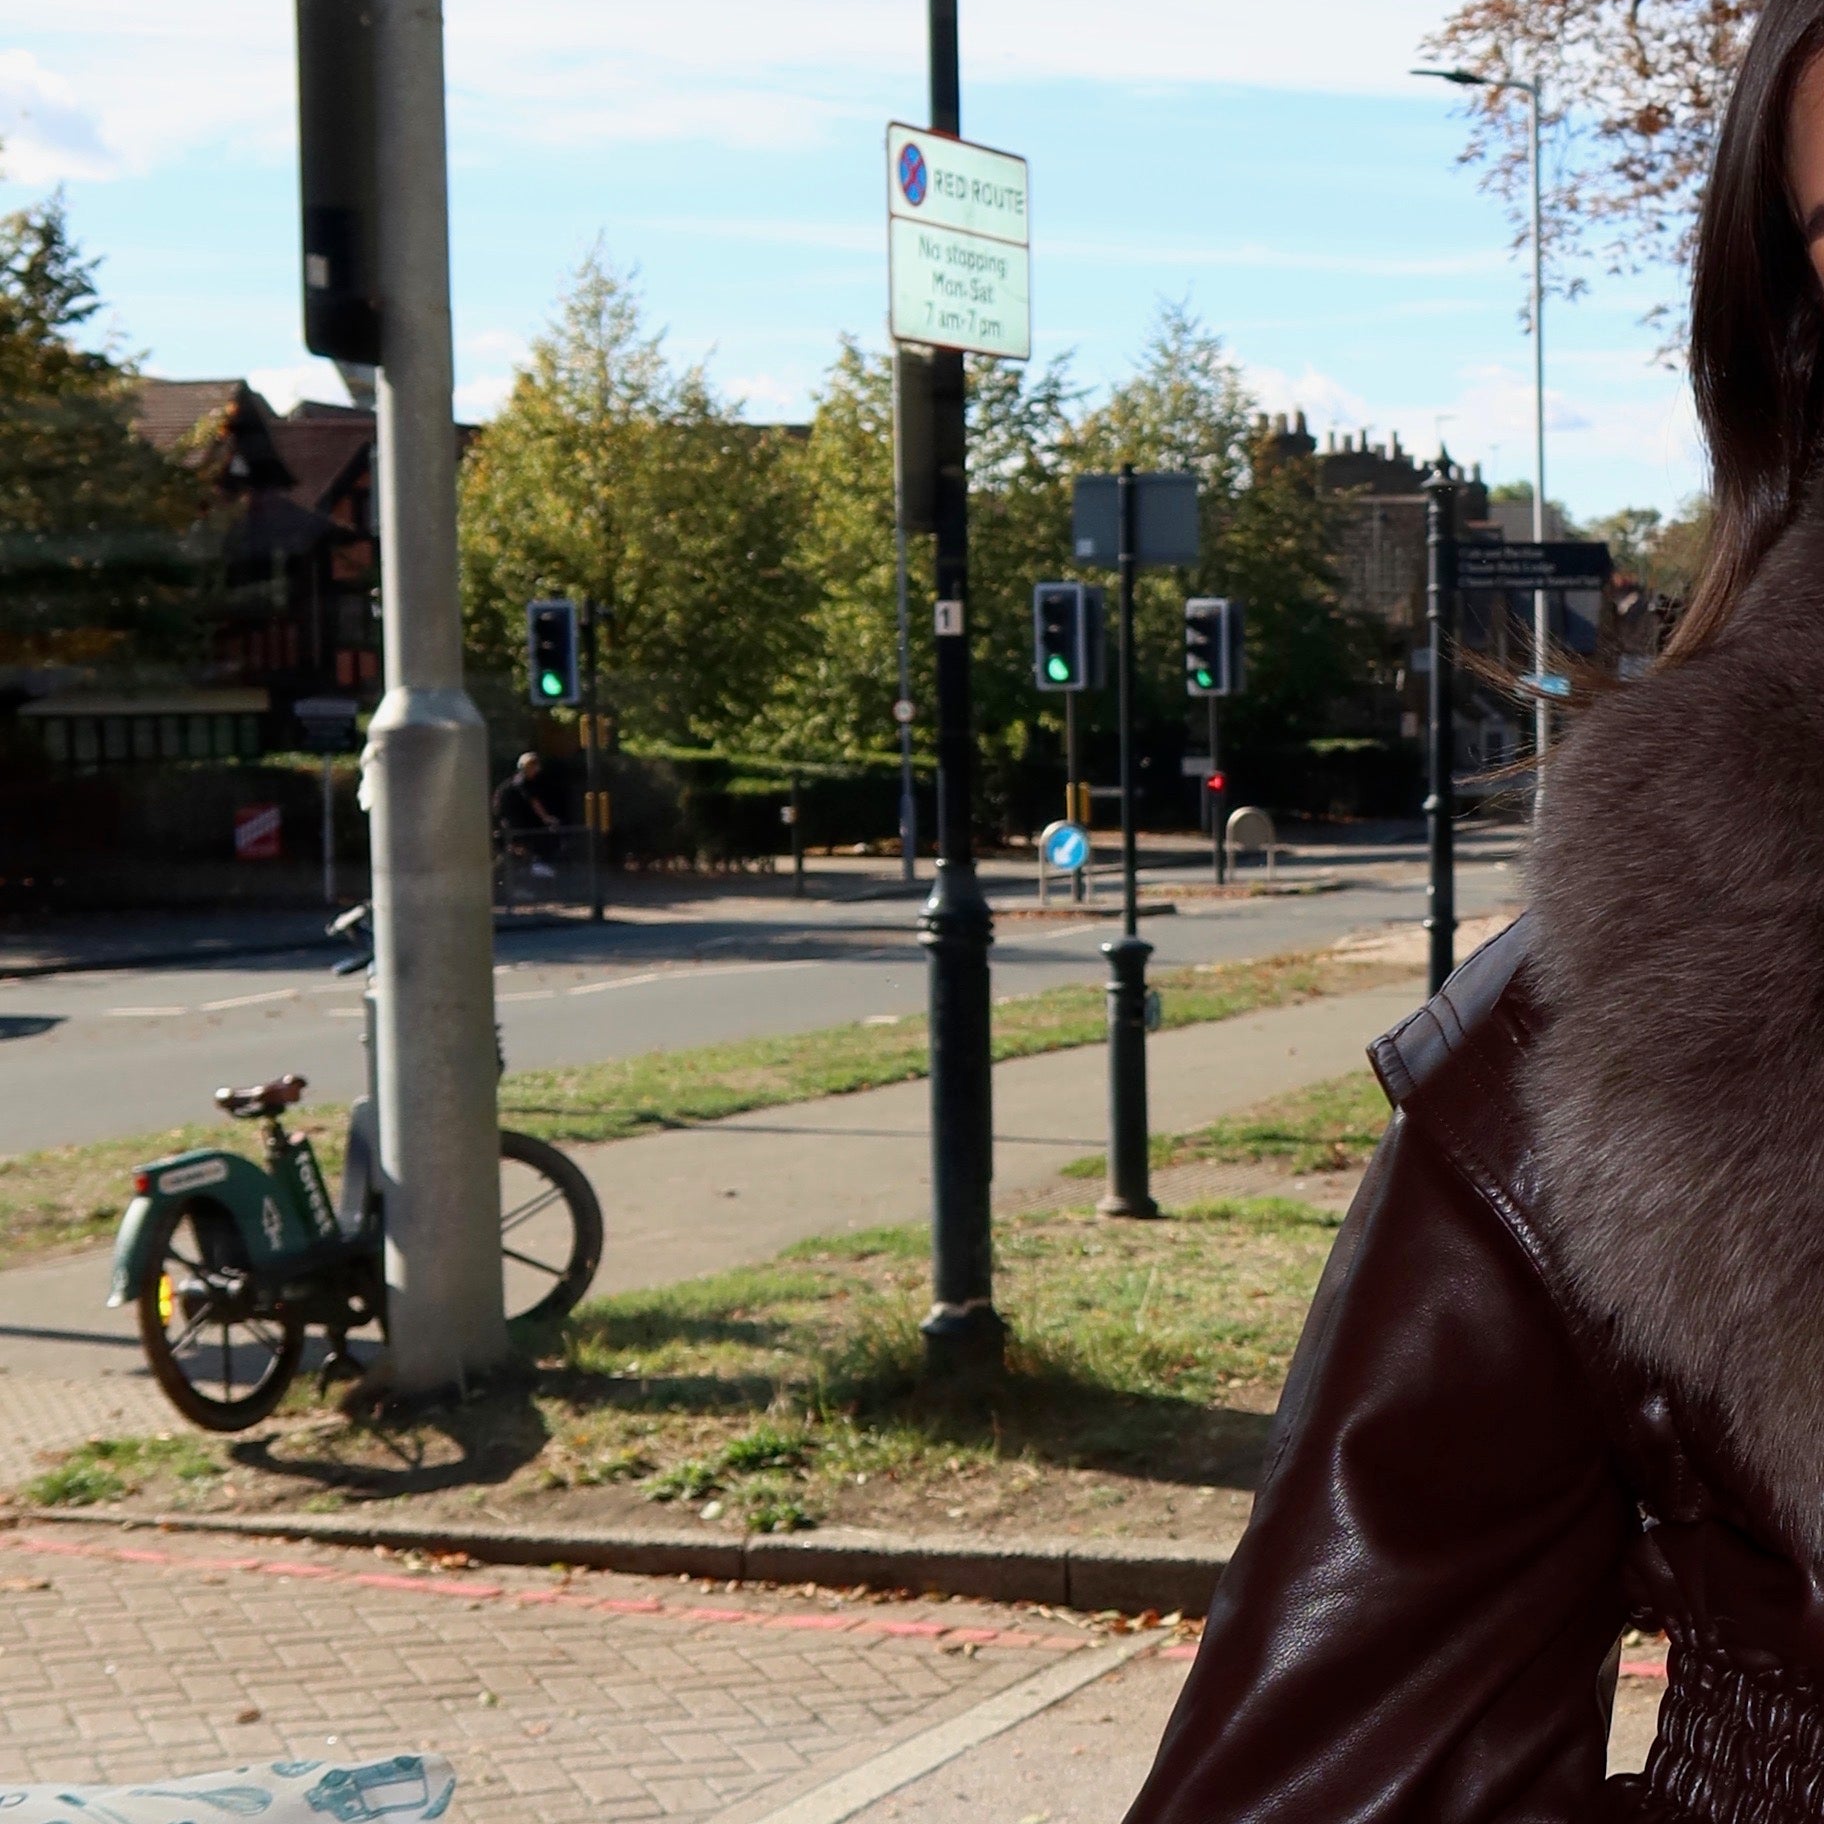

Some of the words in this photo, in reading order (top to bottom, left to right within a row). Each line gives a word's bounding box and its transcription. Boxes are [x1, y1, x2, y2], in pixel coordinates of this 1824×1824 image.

[933, 169, 965, 200] RED
[971, 180, 1024, 215] ROUTE
[919, 233, 940, 262] No
[945, 244, 1007, 280] stopping
[980, 318, 1002, 340] pm
